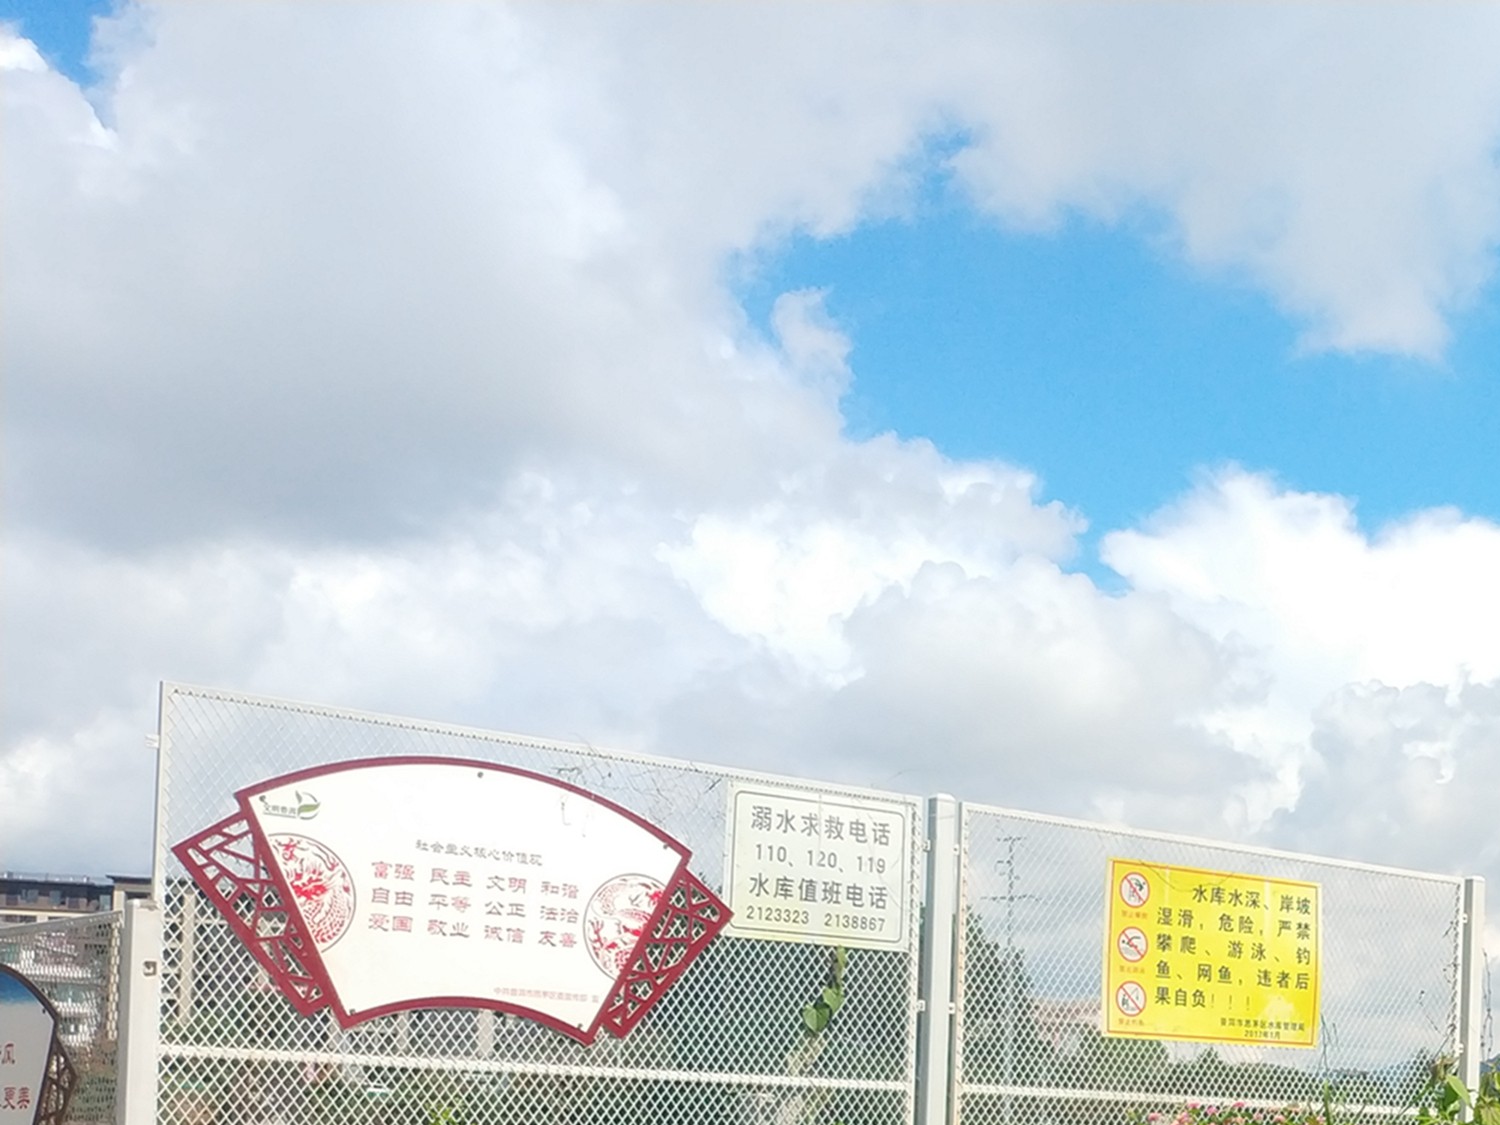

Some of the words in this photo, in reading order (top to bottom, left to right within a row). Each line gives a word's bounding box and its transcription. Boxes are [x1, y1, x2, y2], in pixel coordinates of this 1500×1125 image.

[751, 805, 891, 846] 溺水求救电话
[371, 861, 415, 881] 富强
[430, 868, 472, 887] 民主
[486, 875, 527, 894] 文明
[541, 881, 579, 899] 和谐
[749, 872, 888, 910] 水库值班电话
[371, 887, 414, 906] 自由
[428, 894, 471, 912] 平等
[485, 901, 526, 917] 公正
[540, 905, 579, 924] 法治
[746, 905, 809, 924] 2123323
[824, 913, 886, 932] 2138867
[368, 913, 413, 933] 爱国
[427, 919, 470, 938] 敬业
[484, 925, 525, 944] 诚信
[538, 931, 577, 948] 友善
